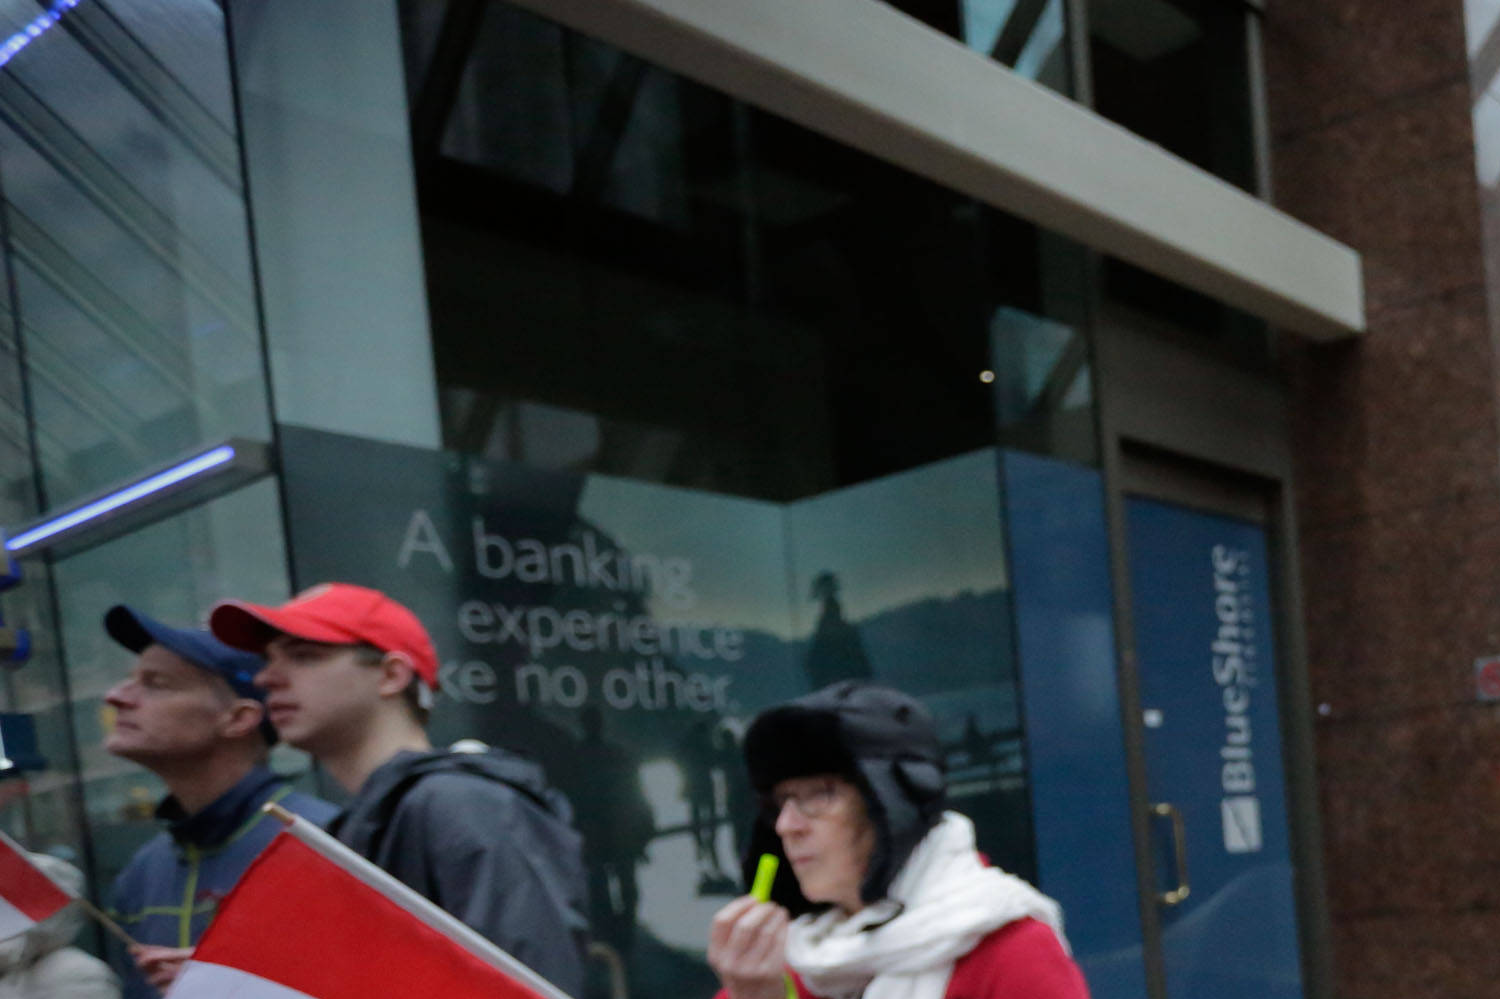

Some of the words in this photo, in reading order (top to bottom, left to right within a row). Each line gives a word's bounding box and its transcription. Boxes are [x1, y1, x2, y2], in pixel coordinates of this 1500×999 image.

[398, 509, 454, 573] A
[472, 515, 695, 611] banking
[456, 599, 746, 662] experience
[1212, 544, 1256, 792] BlueShore
[515, 663, 589, 708] no
